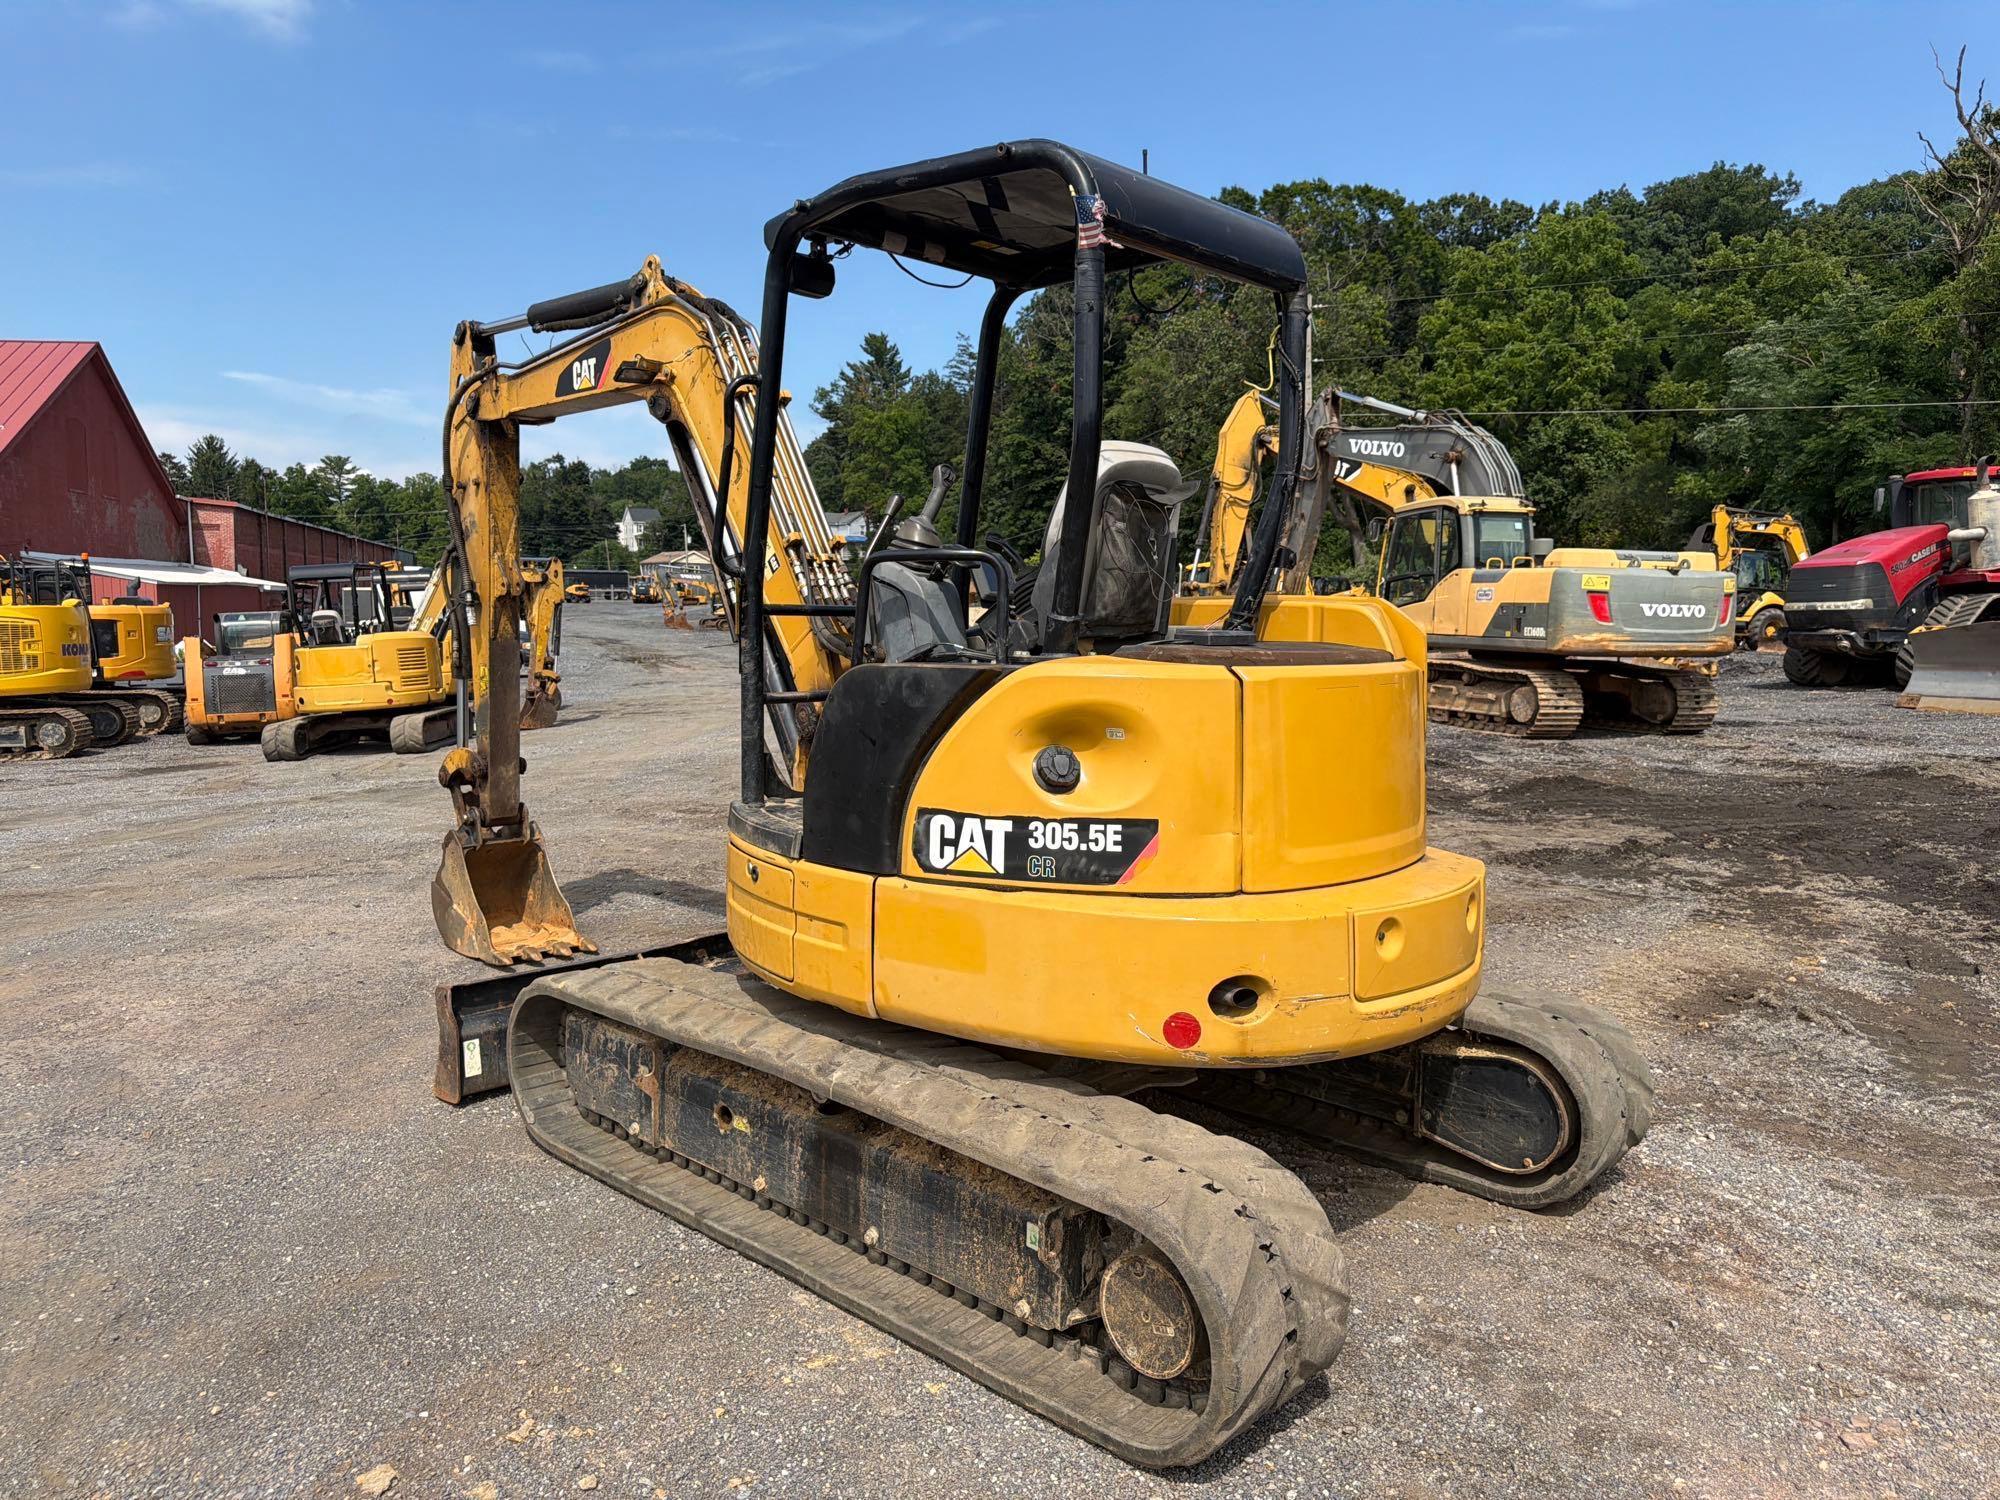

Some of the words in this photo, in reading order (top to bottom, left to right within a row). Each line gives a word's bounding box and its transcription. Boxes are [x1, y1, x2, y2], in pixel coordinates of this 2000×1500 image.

[572, 357, 597, 391] CAT
[1348, 438, 1405, 458] VOLVO
[1911, 546, 1931, 562] CASE
[1640, 603, 1706, 619] VOLVO
[928, 814, 1013, 875] CAT
[1027, 820, 1123, 853] 305.5E
[1027, 855, 1056, 878] CR
